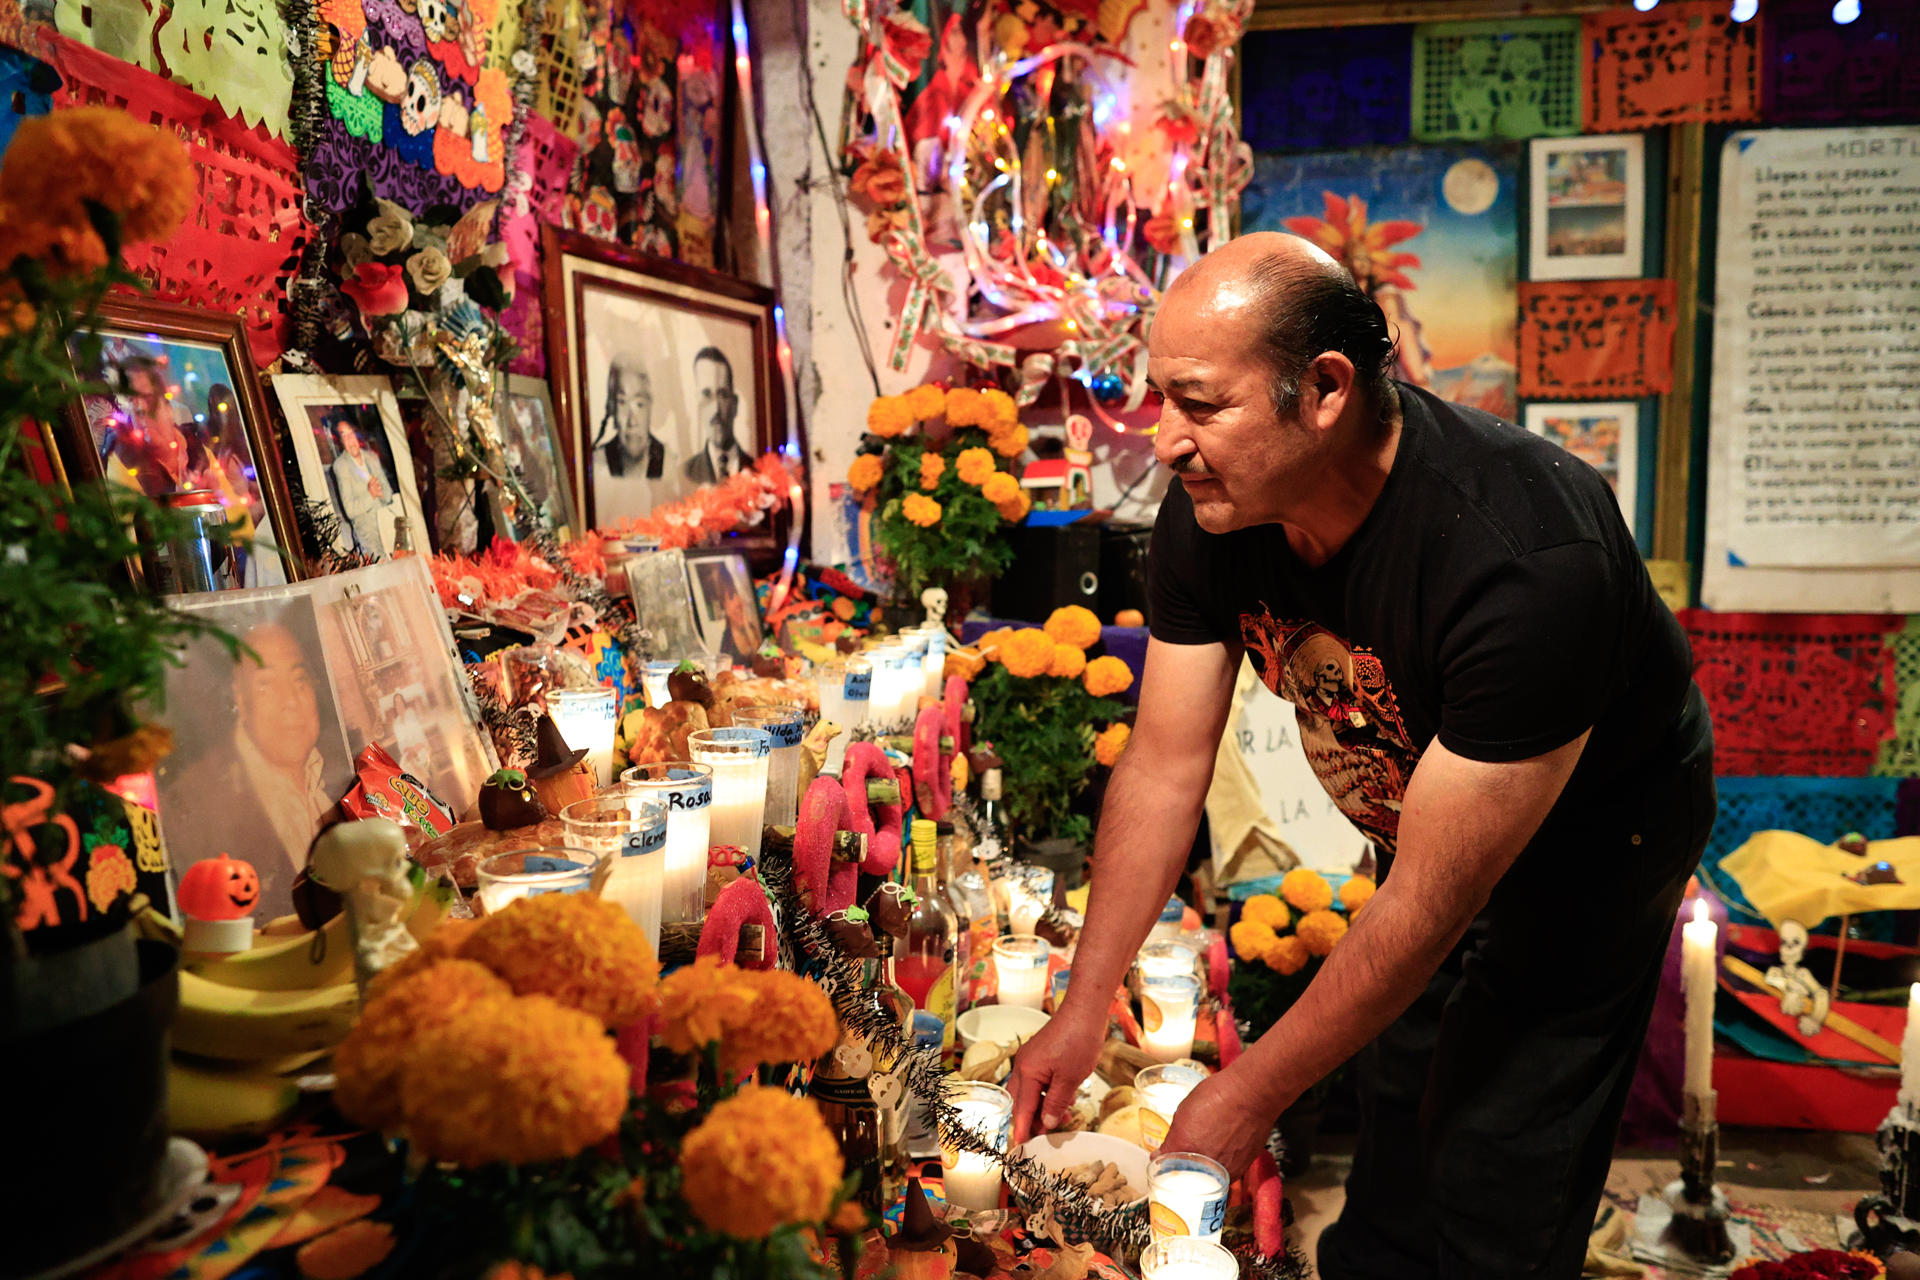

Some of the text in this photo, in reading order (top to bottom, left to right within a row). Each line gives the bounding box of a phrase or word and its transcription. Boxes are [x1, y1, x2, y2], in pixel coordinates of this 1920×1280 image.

[1265, 726, 1294, 753] LA
[389, 776, 430, 817] Que
[668, 790, 712, 811] Rosa
[1280, 798, 1311, 824] LA
